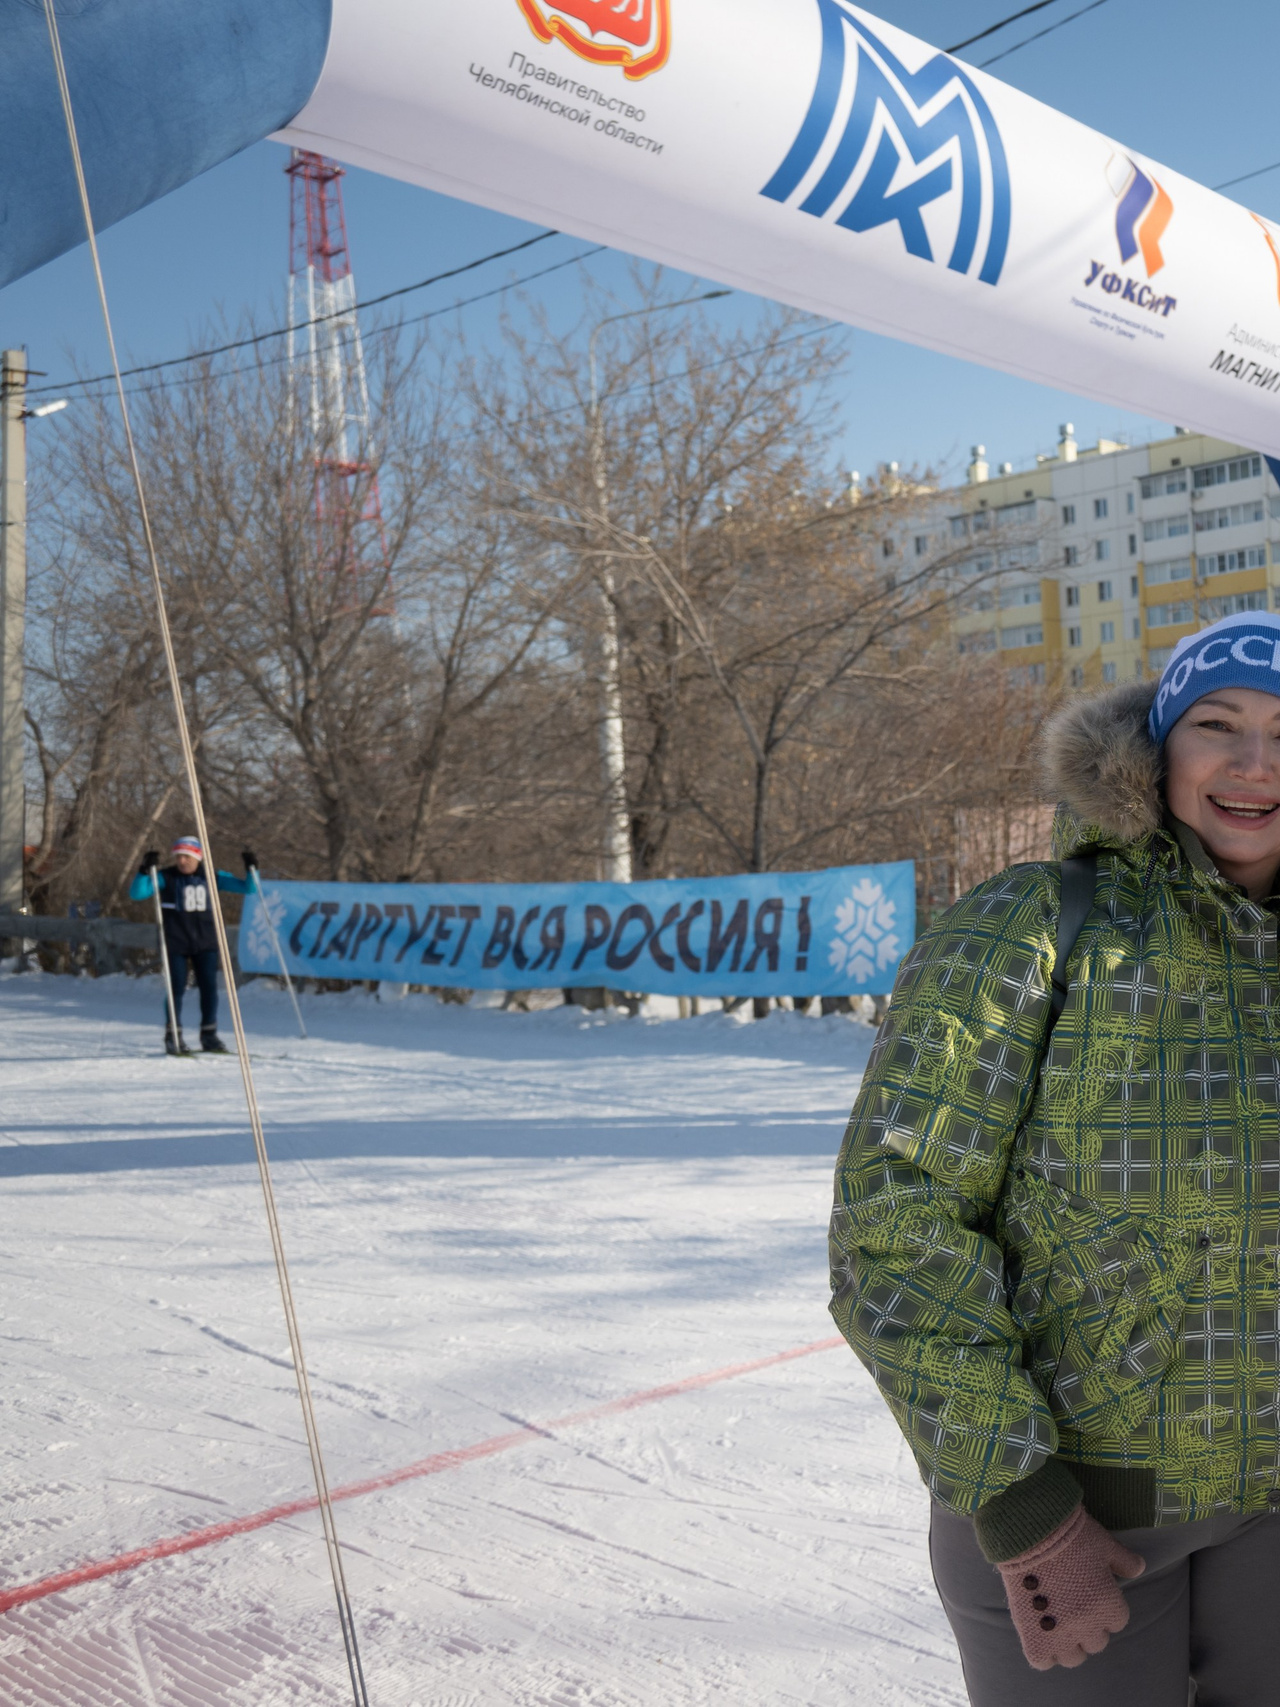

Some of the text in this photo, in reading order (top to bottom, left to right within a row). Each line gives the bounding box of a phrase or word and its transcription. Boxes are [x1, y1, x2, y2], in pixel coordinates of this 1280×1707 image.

[469, 62, 664, 155] Челябинской области
[508, 52, 646, 122] Правительство
[184, 884, 206, 912] 89
[289, 902, 481, 967] СТАРТУЕТ
[481, 905, 567, 970] ВСЯ
